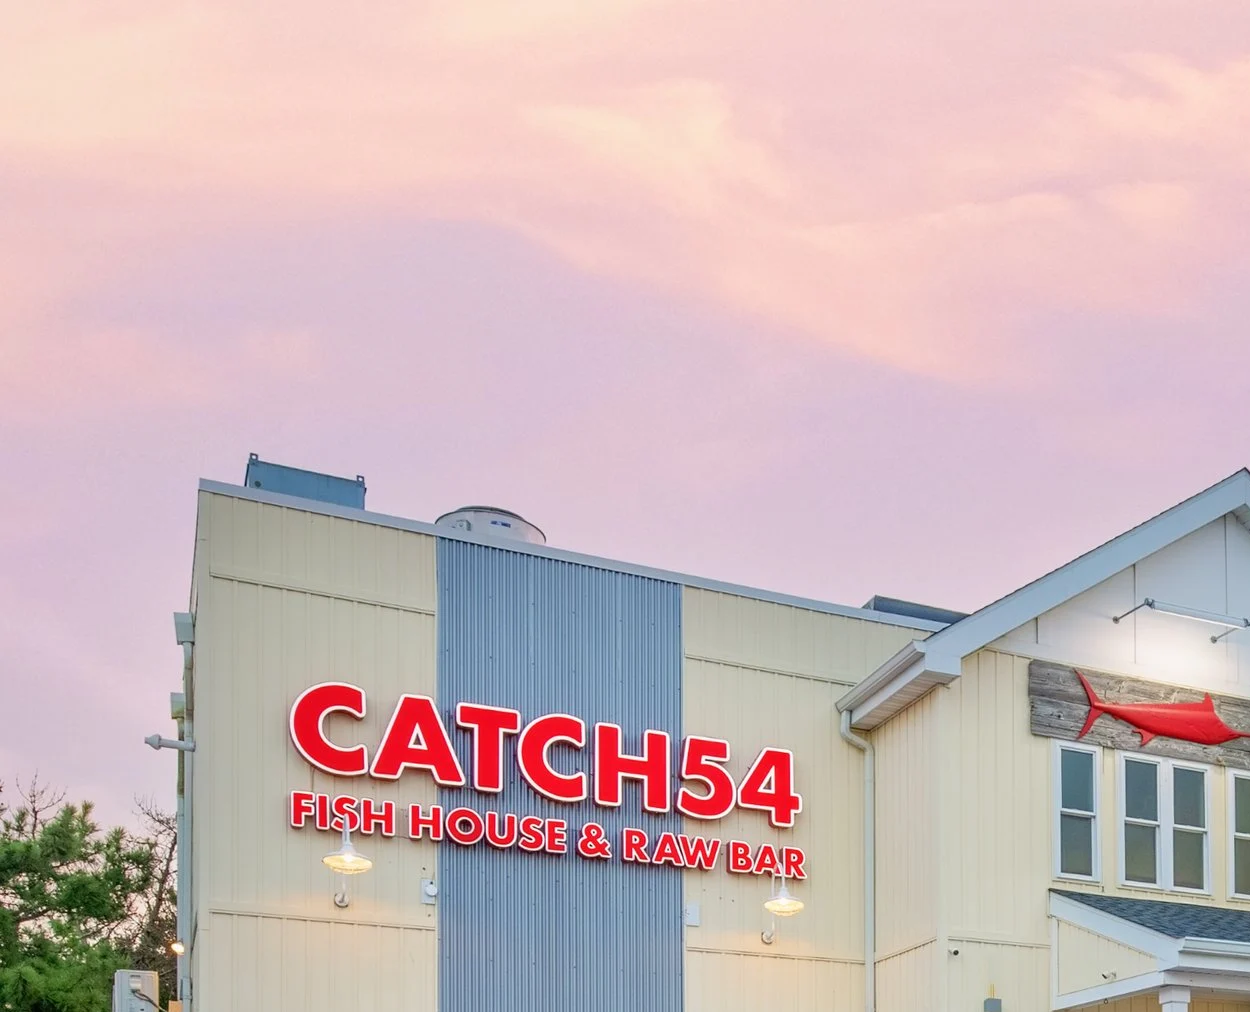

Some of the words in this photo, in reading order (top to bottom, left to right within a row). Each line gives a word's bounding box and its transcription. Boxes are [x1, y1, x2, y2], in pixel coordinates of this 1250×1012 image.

[290, 681, 803, 828] CATCH54
[290, 790, 395, 835] FISH
[408, 803, 568, 854] HOUSE
[577, 821, 612, 859] &
[622, 832, 723, 871] RAW
[729, 840, 808, 880] BAR
